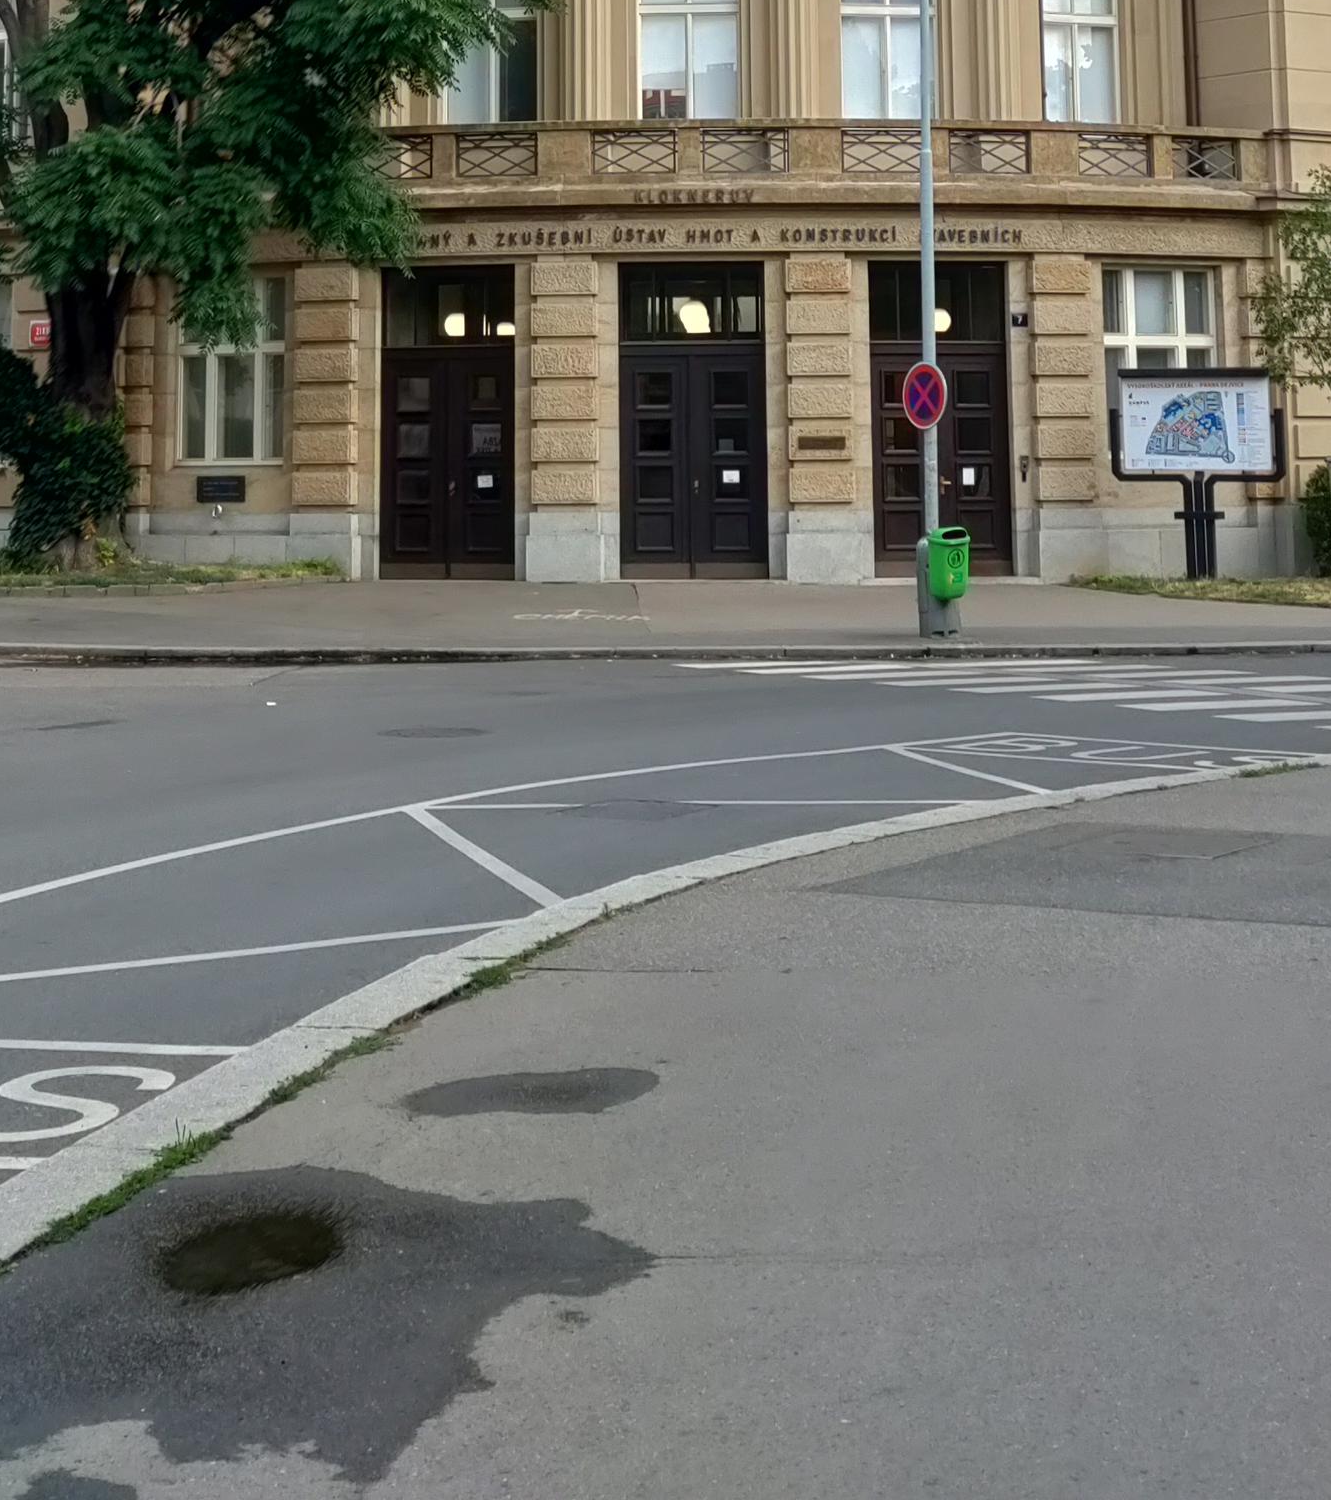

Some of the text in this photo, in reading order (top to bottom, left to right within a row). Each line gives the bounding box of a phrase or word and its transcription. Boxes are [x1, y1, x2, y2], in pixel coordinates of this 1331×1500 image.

[467, 232, 477, 247] A
[496, 227, 592, 247] ZKUŠEBNÍ
[612, 226, 667, 244] ÚSTAV
[686, 228, 734, 244] HMOT
[750, 228, 761, 243] A
[780, 225, 897, 244] KONSTRUKCÍ
[920, 226, 1023, 244] AVEBNÍCH
[944, 737, 1300, 771] BUS
